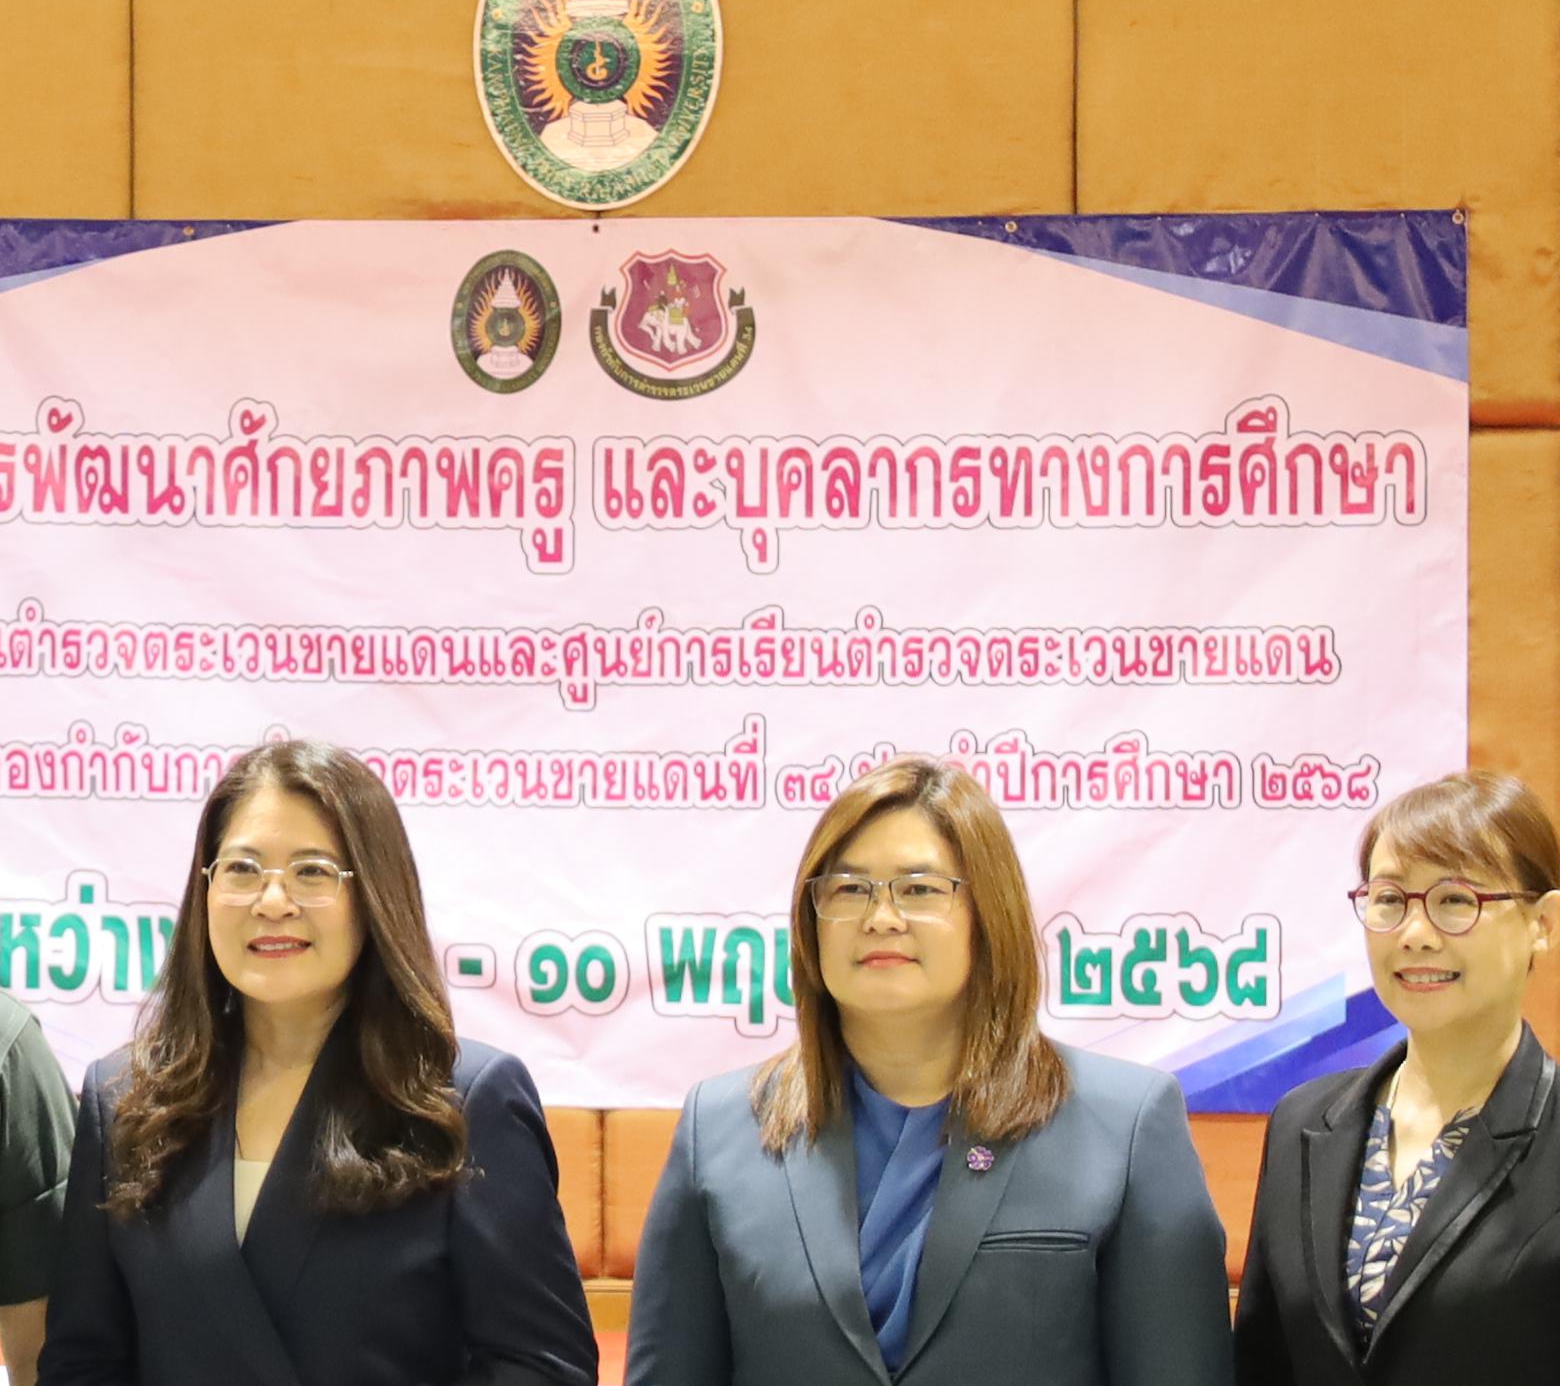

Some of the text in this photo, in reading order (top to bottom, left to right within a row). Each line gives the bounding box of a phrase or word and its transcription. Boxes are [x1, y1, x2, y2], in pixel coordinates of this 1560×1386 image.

[603, 404, 1417, 564] และบุคลากรทางการศึกษา
[783, 765, 837, 803] ๓๔
[1260, 759, 1374, 803] ๒๕๖๘
[529, 944, 616, 1004] ๑๐
[1060, 928, 1268, 1008] ๒๕๖๘
